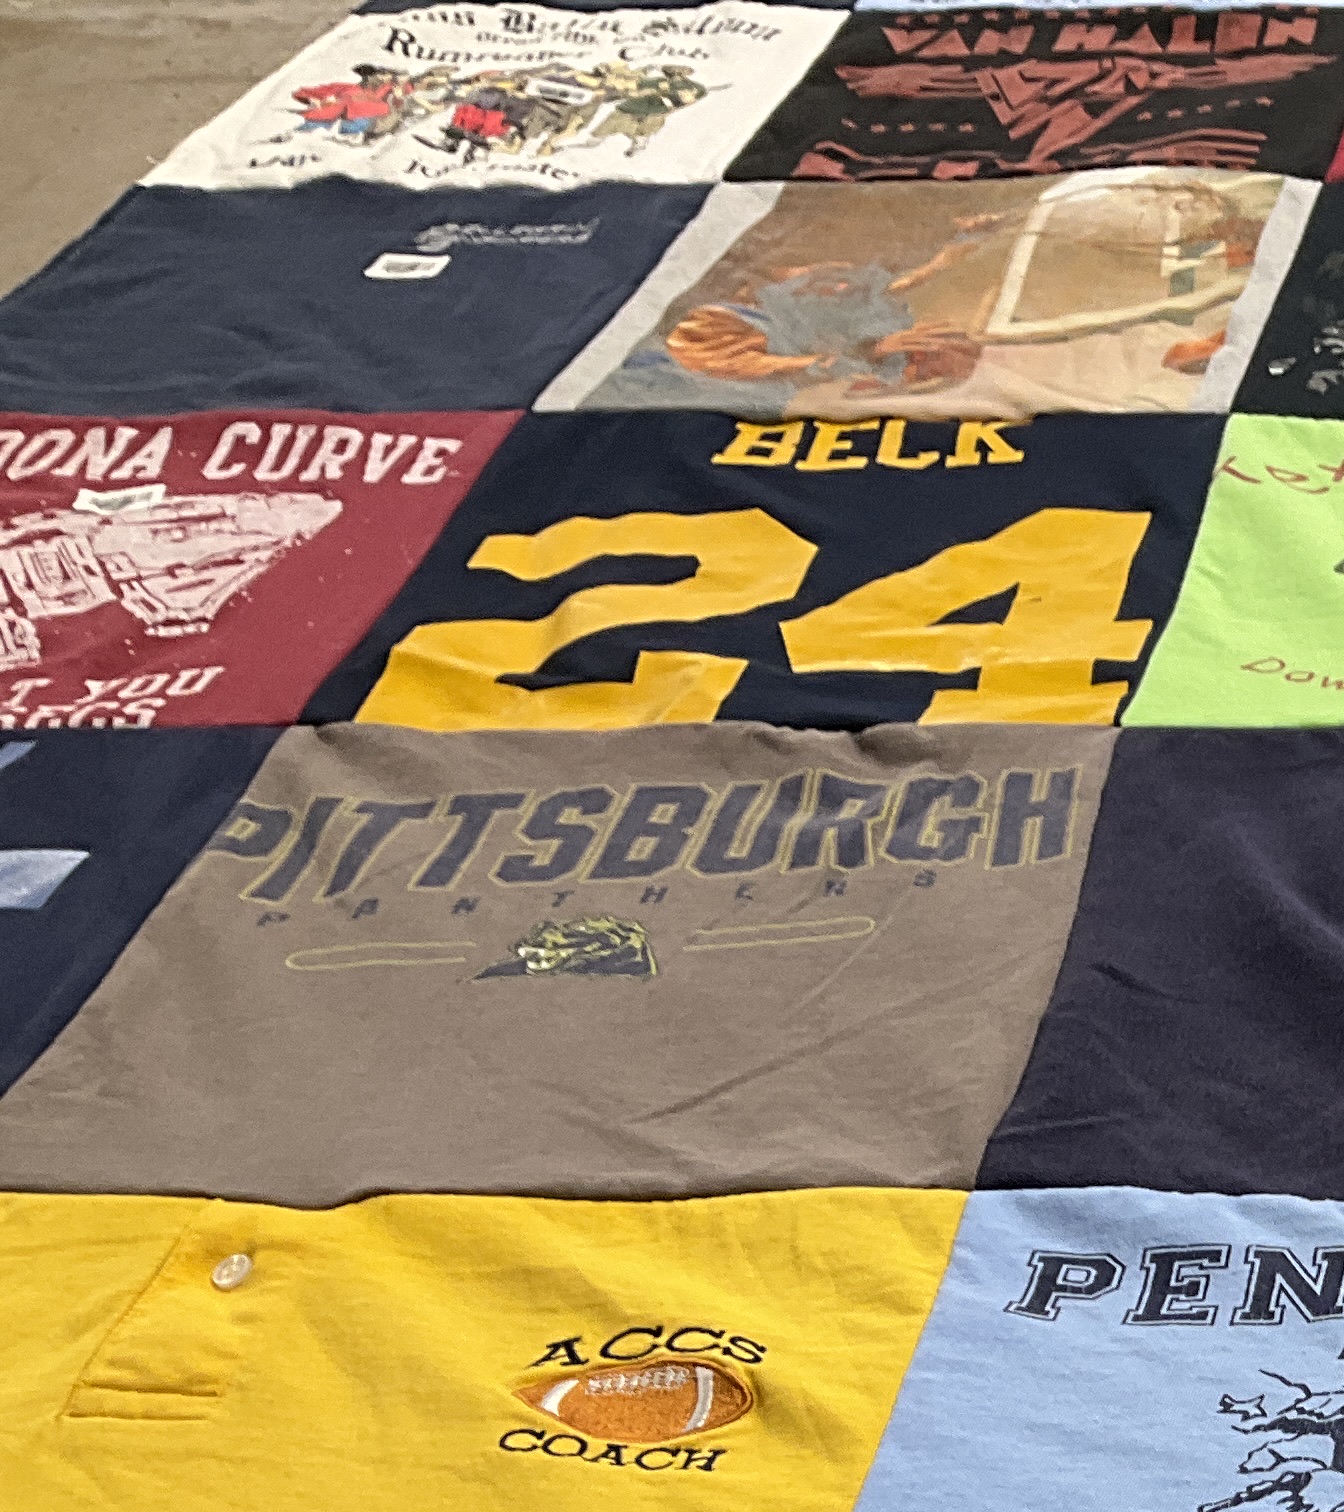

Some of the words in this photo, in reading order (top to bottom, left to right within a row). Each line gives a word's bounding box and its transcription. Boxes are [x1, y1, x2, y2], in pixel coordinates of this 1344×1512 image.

[202, 422, 464, 485] CURVE
[711, 418, 1026, 471] BECK
[353, 507, 1154, 731] 24
[73, 665, 226, 705] YOU
[193, 764, 1085, 905] PITTSBURGH
[256, 868, 938, 928] PANTHERS
[525, 1325, 768, 1369] ACCS
[499, 1427, 729, 1472] COACH
